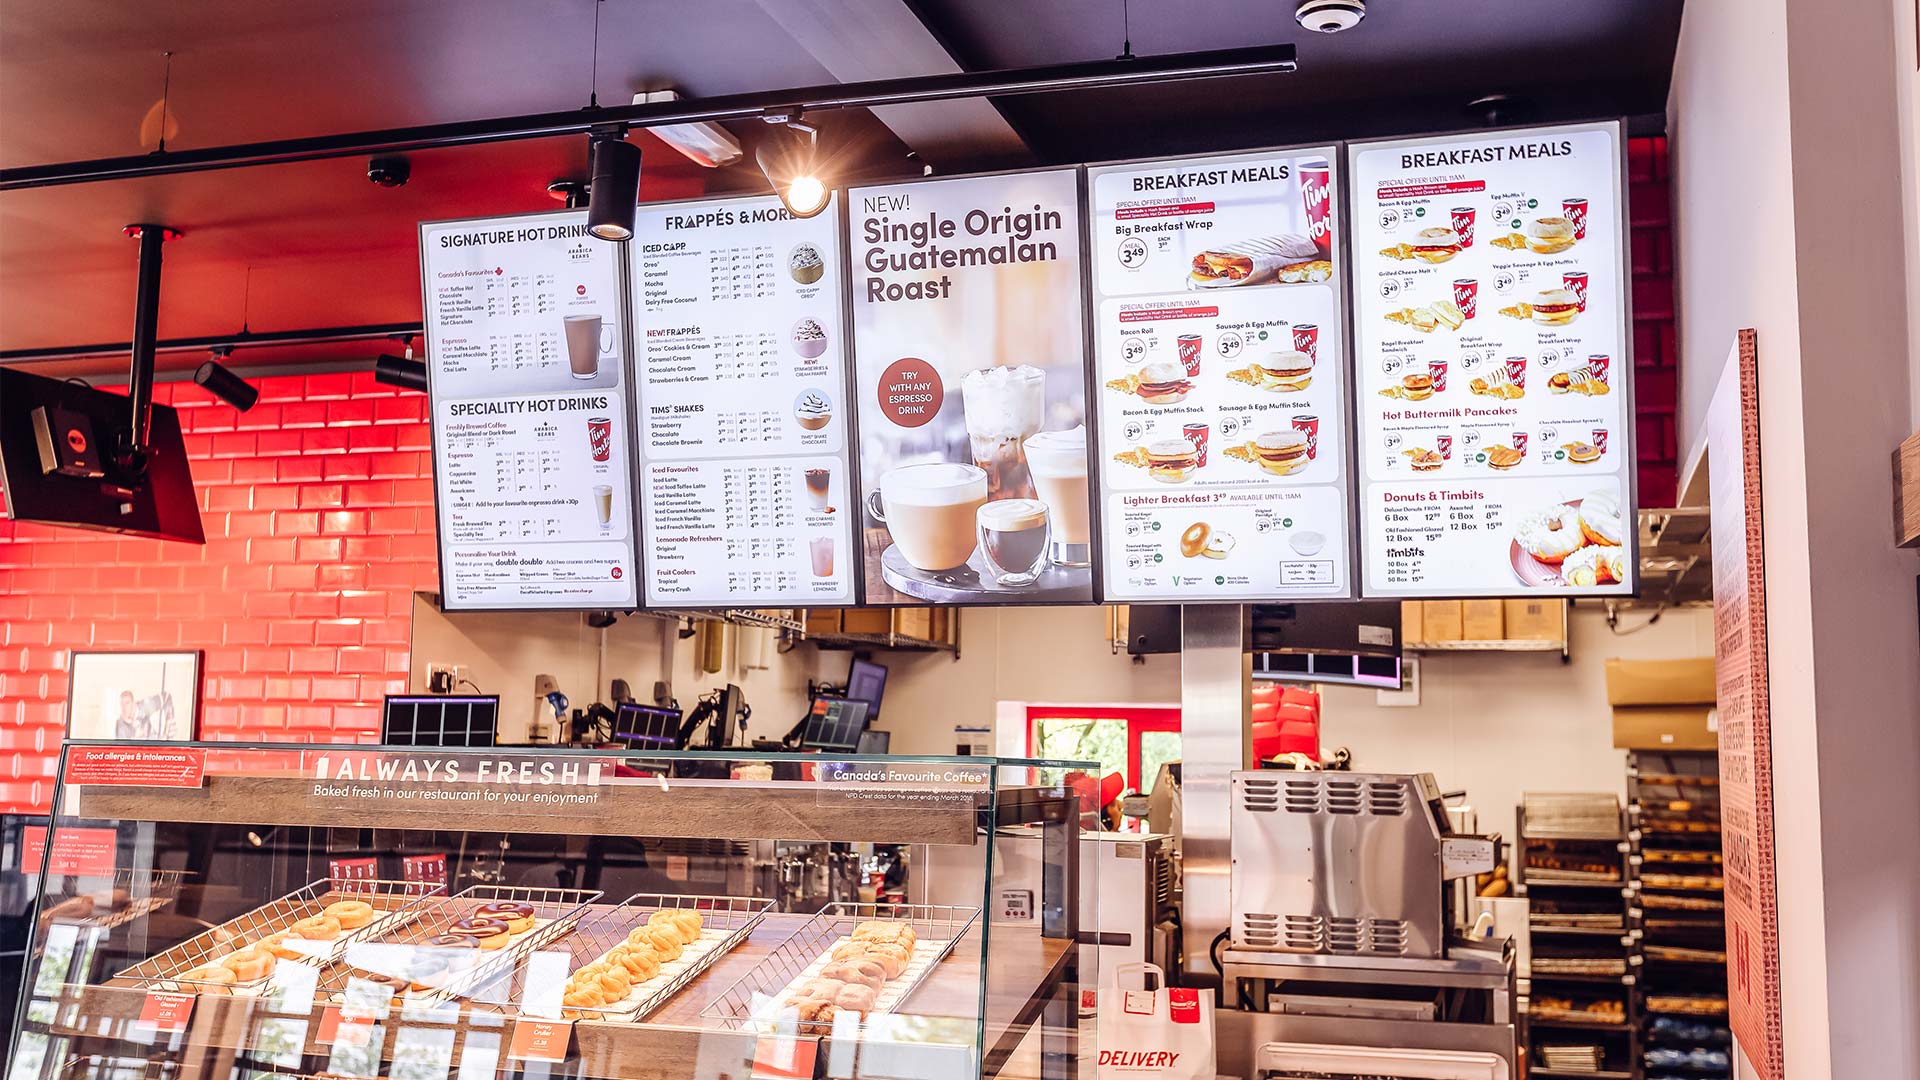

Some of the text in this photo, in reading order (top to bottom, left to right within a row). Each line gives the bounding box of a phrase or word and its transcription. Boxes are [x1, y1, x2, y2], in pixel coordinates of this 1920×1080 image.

[1401, 141, 1572, 170] BREAKFAST MEALS
[1133, 166, 1289, 192] BREAKFAST MEALS
[864, 194, 910, 213] NEW!
[1116, 200, 1140, 208] SPECIAL
[666, 208, 734, 230] FRAPPÉS
[740, 212, 750, 224] &
[864, 204, 1061, 248] Single Origin
[1116, 220, 1213, 236] Big Breakfast Wrap
[441, 224, 589, 248] SIGNATURE HOT DRINK
[643, 244, 661, 253] ICED
[865, 236, 1057, 273] Guatemalan
[867, 276, 952, 303] Roast
[1252, 321, 1264, 329] Egg
[902, 372, 918, 380] TRY
[890, 382, 931, 392] WITH ANY
[889, 394, 933, 403] ESPRESSO
[450, 396, 608, 416] SPECIALITY HOT DRINKS
[674, 404, 704, 413] SHAKES
[898, 406, 925, 415] DRINK
[1255, 404, 1267, 412] Egg
[1150, 409, 1162, 417] Egg
[1383, 407, 1518, 420] Hot Buttermilk Pancakes
[1124, 496, 1159, 506] Lighter
[1161, 494, 1210, 504] Breakfast
[1384, 490, 1484, 502] Donuts & Timbits
[1386, 547, 1424, 558] timbits
[86, 752, 104, 760] Food
[104, 753, 135, 762] allergies
[143, 753, 186, 762] intolerances
[336, 759, 580, 785] ALWAYS FRESH
[834, 770, 885, 781] Canada's
[888, 772, 941, 782] Favourite
[313, 784, 598, 806] Baked fresh in our restaurant for your enjoyment
[1098, 1051, 1180, 1067] DELIVERY
